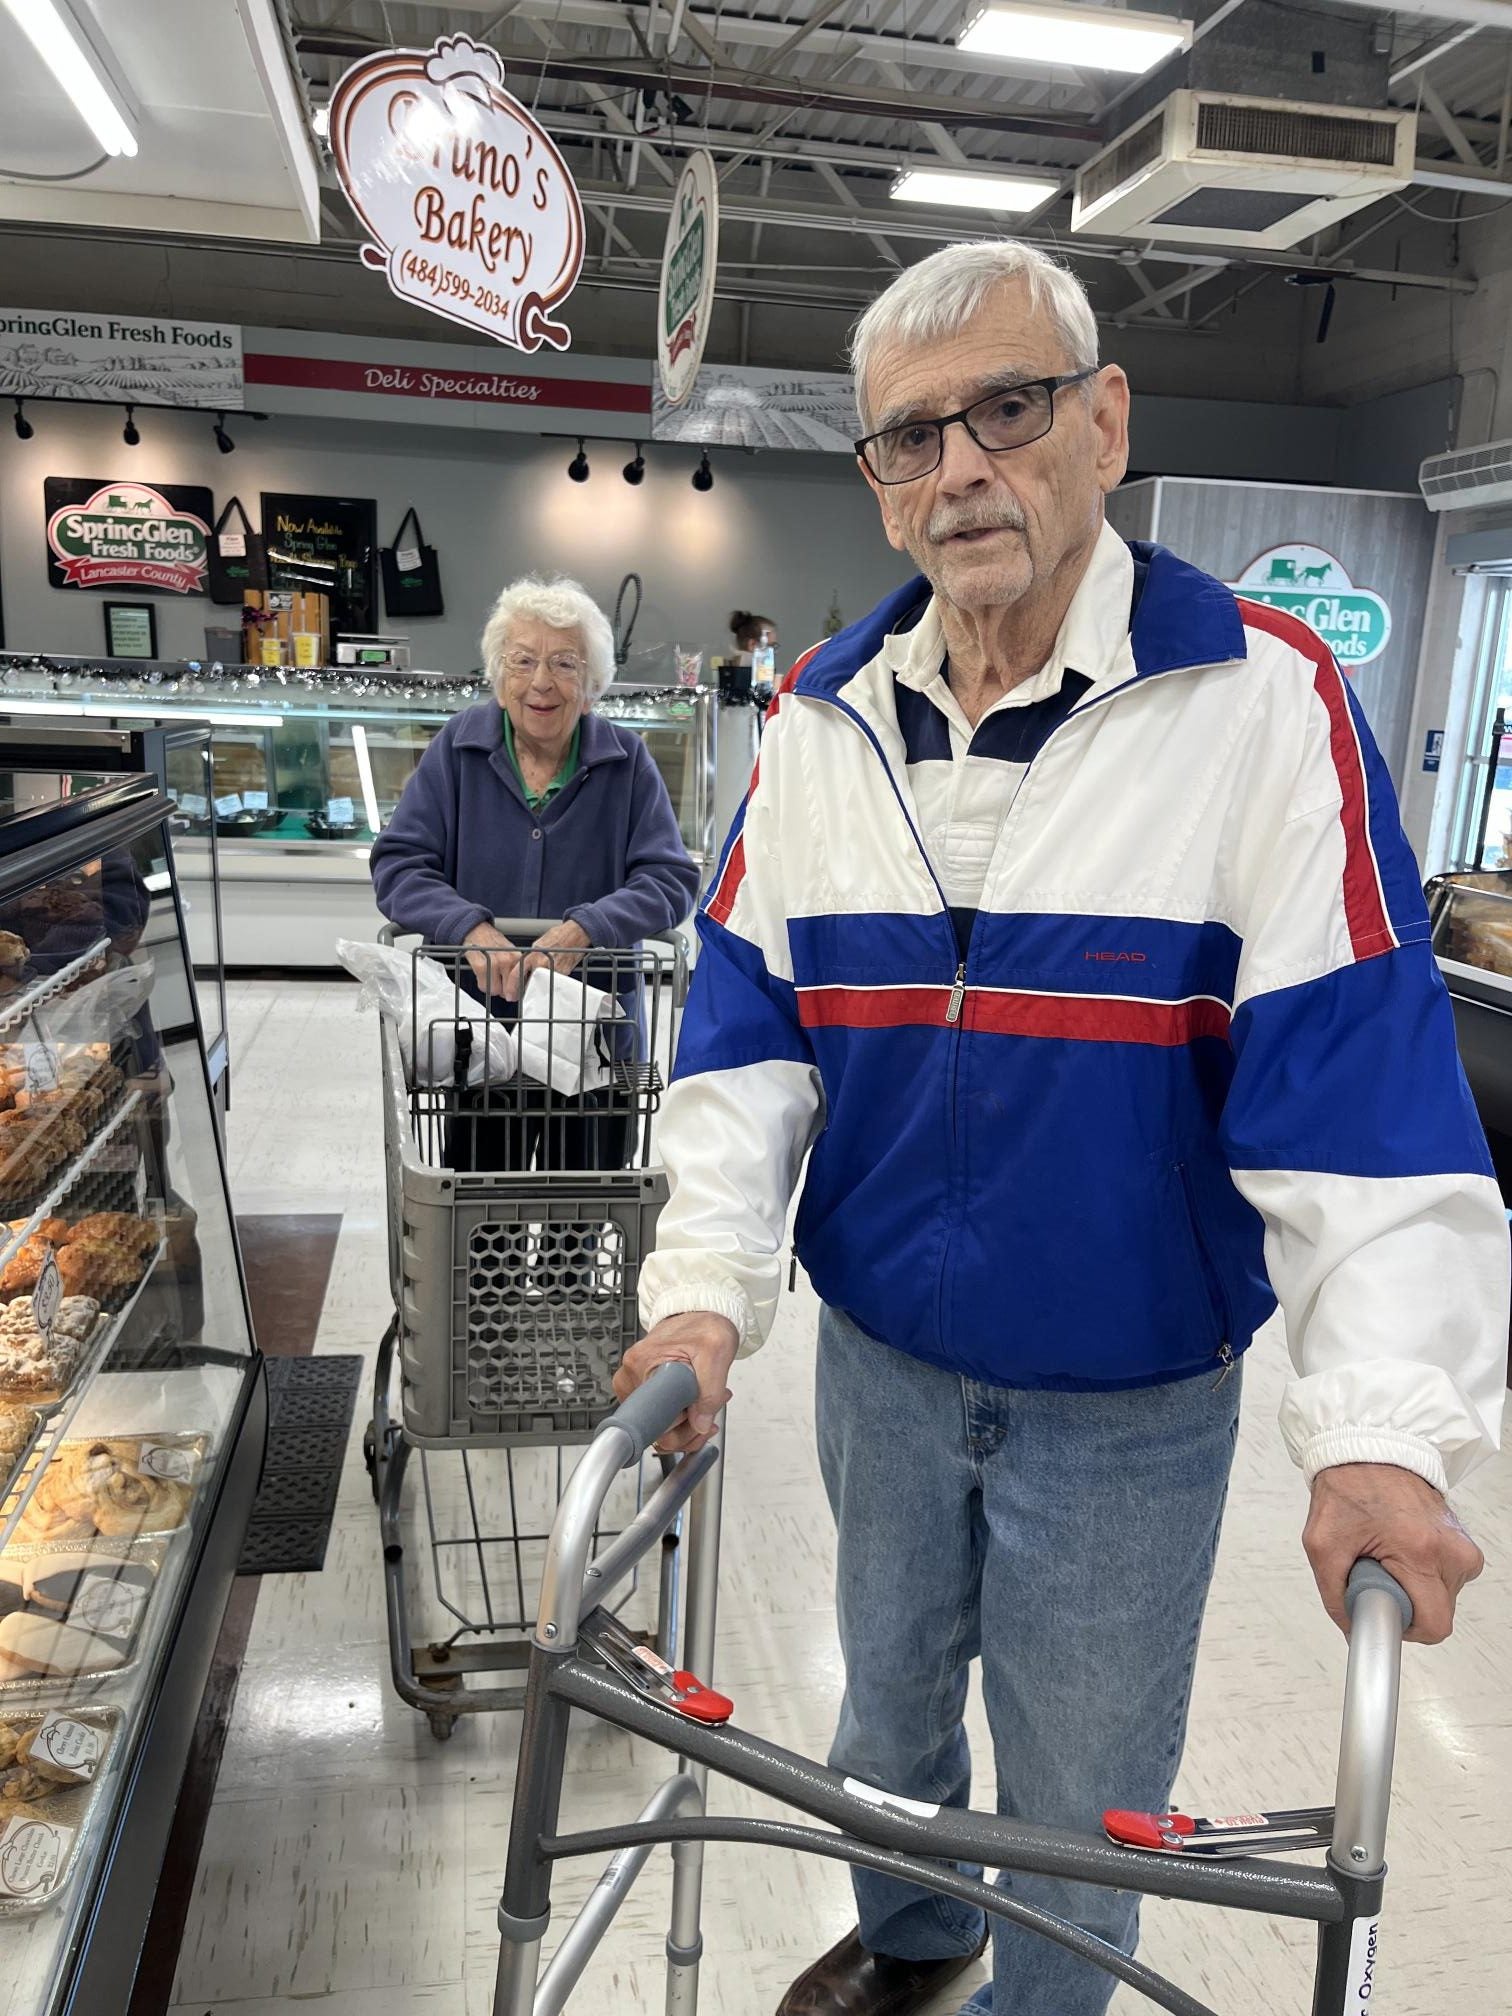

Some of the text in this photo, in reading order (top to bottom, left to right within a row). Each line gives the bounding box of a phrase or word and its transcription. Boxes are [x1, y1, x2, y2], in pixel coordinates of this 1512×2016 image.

[413, 186, 533, 285] Bakery
[400, 249, 511, 321] (484)599-2034
[0, 315, 233, 349] ringGlen Fresh Foods
[364, 368, 542, 400] Deli Specialties
[66, 515, 194, 545] SpringGlen
[91, 539, 195, 562] Fresh Foods
[80, 564, 187, 588] Lancaster County
[1326, 632, 1367, 656] ods
[1085, 951, 1146, 962] HEAD
[1358, 1922, 1379, 2000] Oxygen
